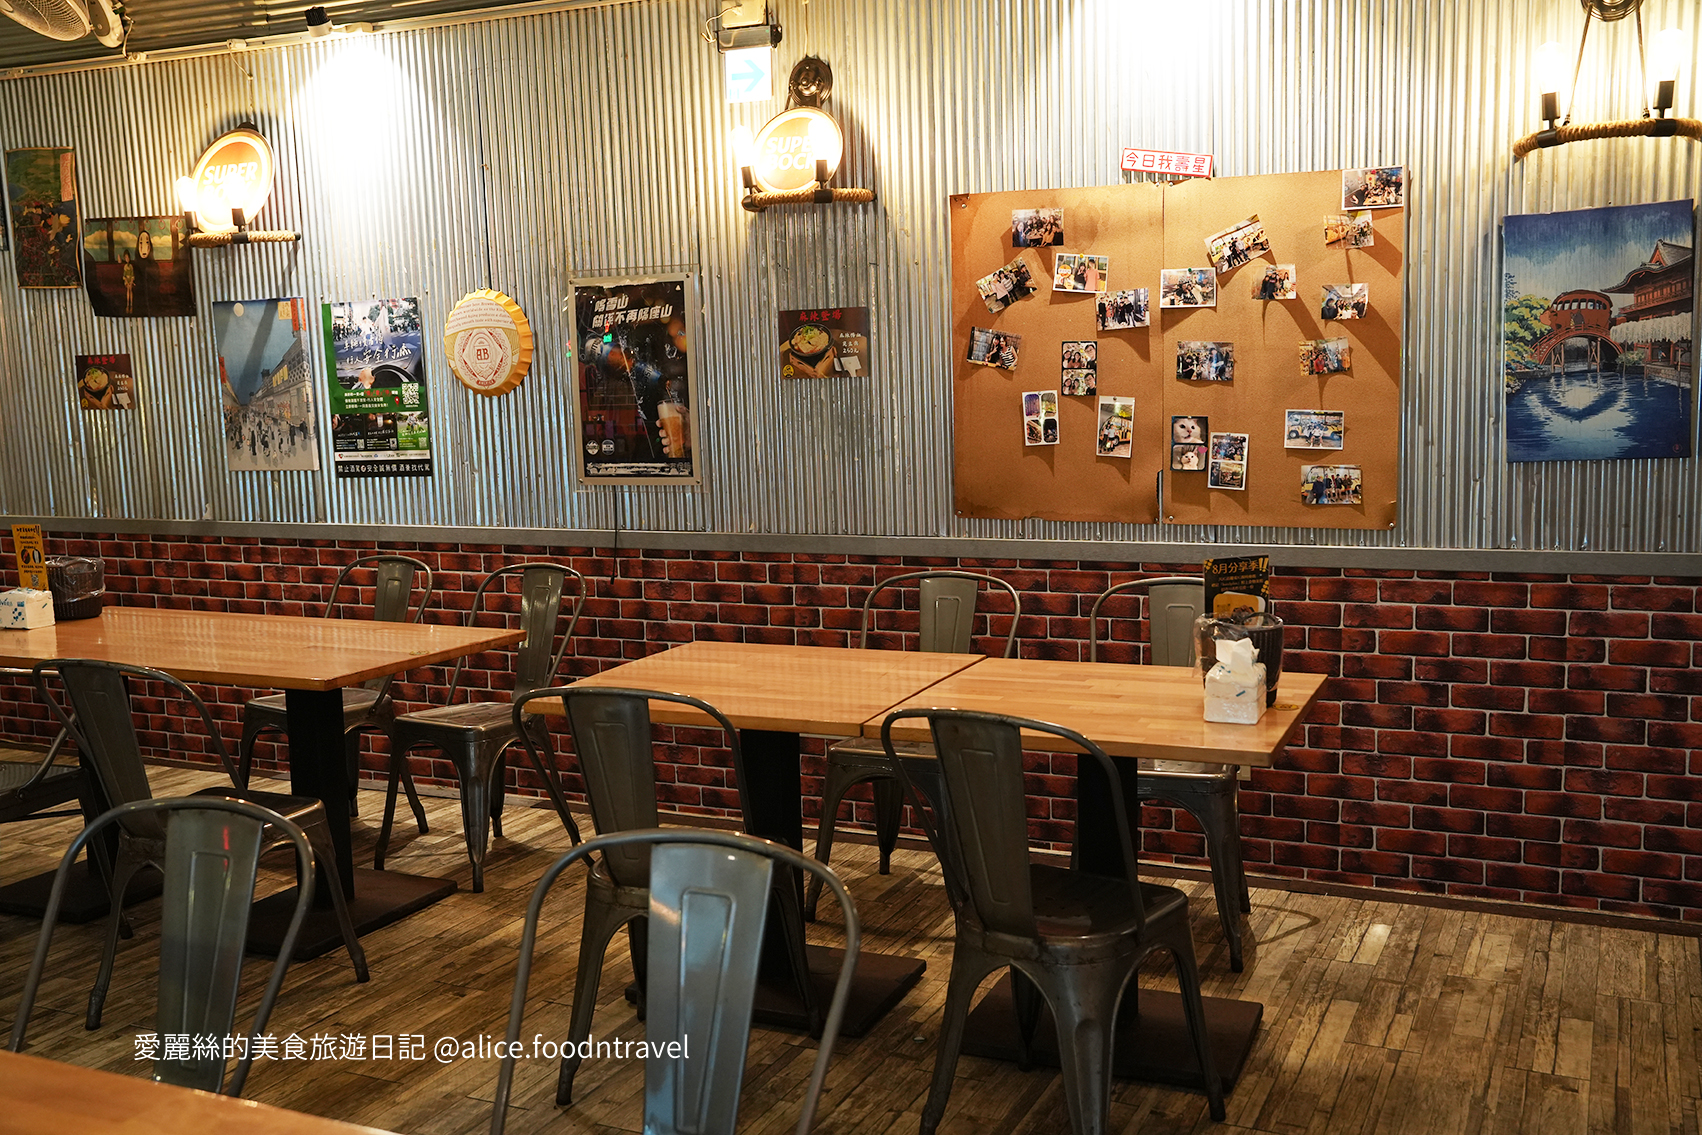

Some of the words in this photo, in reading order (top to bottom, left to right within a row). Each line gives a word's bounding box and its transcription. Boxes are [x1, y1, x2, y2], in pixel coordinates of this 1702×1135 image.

[203, 162, 259, 185] SUPER
[1126, 151, 1206, 174] 今日我壽星
